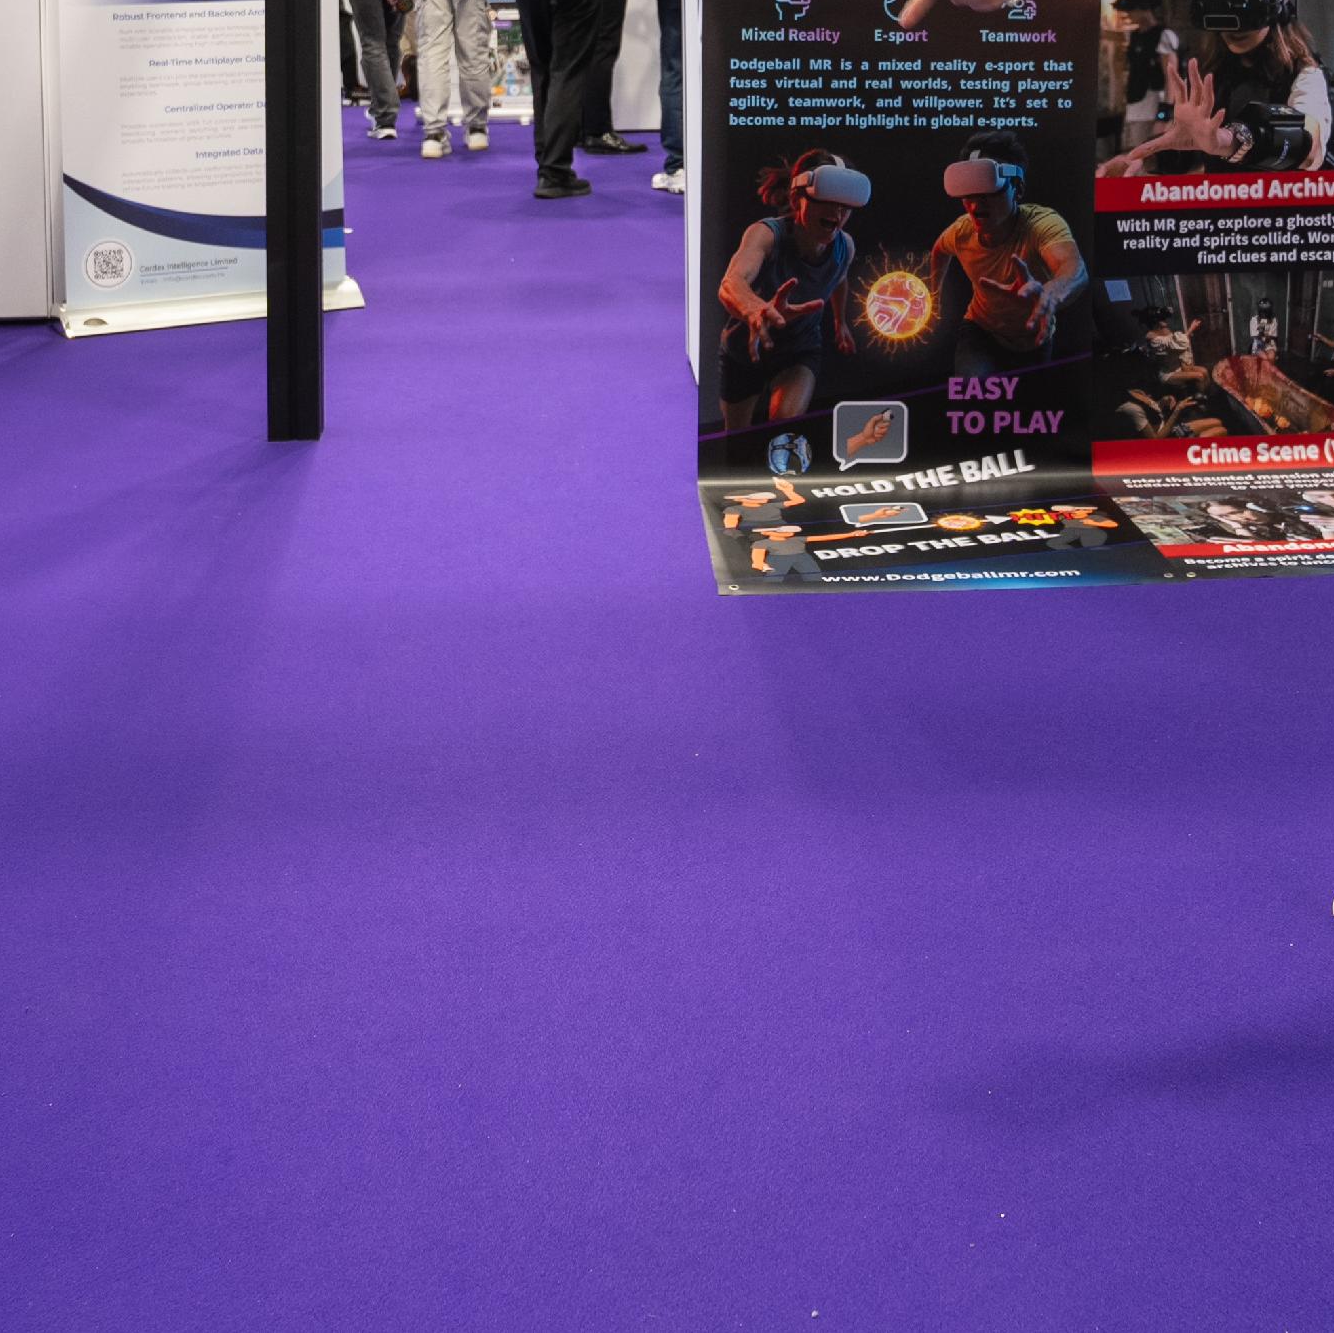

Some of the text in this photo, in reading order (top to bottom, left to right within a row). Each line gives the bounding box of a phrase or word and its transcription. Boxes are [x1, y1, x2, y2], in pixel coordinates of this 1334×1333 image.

[112, 12, 144, 22] Robust
[741, 27, 841, 45] Mixed Reality
[874, 29, 929, 45] E-sport
[979, 29, 1057, 43] Teamwork
[730, 58, 1074, 74] Dodgeball MR is a mixed reality e-sport that
[729, 77, 767, 89] fuses
[775, 77, 823, 89] virtual
[830, 77, 857, 89] and
[865, 77, 893, 89] real
[900, 77, 952, 91] worlds,
[960, 78, 1010, 92] testing
[729, 95, 778, 110] agility,
[788, 95, 865, 109] teamwork,
[875, 96, 902, 108] and
[912, 96, 984, 111] willpower.
[1026, 98, 1049, 108] set
[1058, 98, 1072, 108] to
[729, 113, 1038, 129] become a major highlight in global e-sports.
[195, 147, 263, 160] Integrated Data
[1140, 178, 1264, 203] Abandoned
[1117, 218, 1150, 232] With
[1153, 218, 1176, 232] MR
[1179, 219, 1215, 234] gear,
[1217, 215, 1272, 231] explore
[1275, 217, 1283, 227] a
[1123, 235, 1170, 251] reality
[1172, 234, 1200, 248] and
[1203, 233, 1249, 249] spirits
[1251, 231, 1304, 245] collide.
[1197, 250, 1226, 265] find
[1228, 250, 1267, 263] clues
[1269, 249, 1297, 262] and
[948, 377, 1019, 400] EASY
[946, 410, 1065, 434] TO PLAY
[1187, 442, 1252, 466] Crime
[1256, 442, 1319, 463] Scene
[810, 449, 1036, 498] HOLD THE BALL
[1165, 476, 1191, 484] the
[1193, 474, 1255, 482] haunted
[1257, 472, 1320, 480] mansion
[813, 529, 1061, 561] DROP THE BALL
[1184, 556, 1250, 565] Become
[821, 568, 1080, 584] www.Dodgeballmr.com
